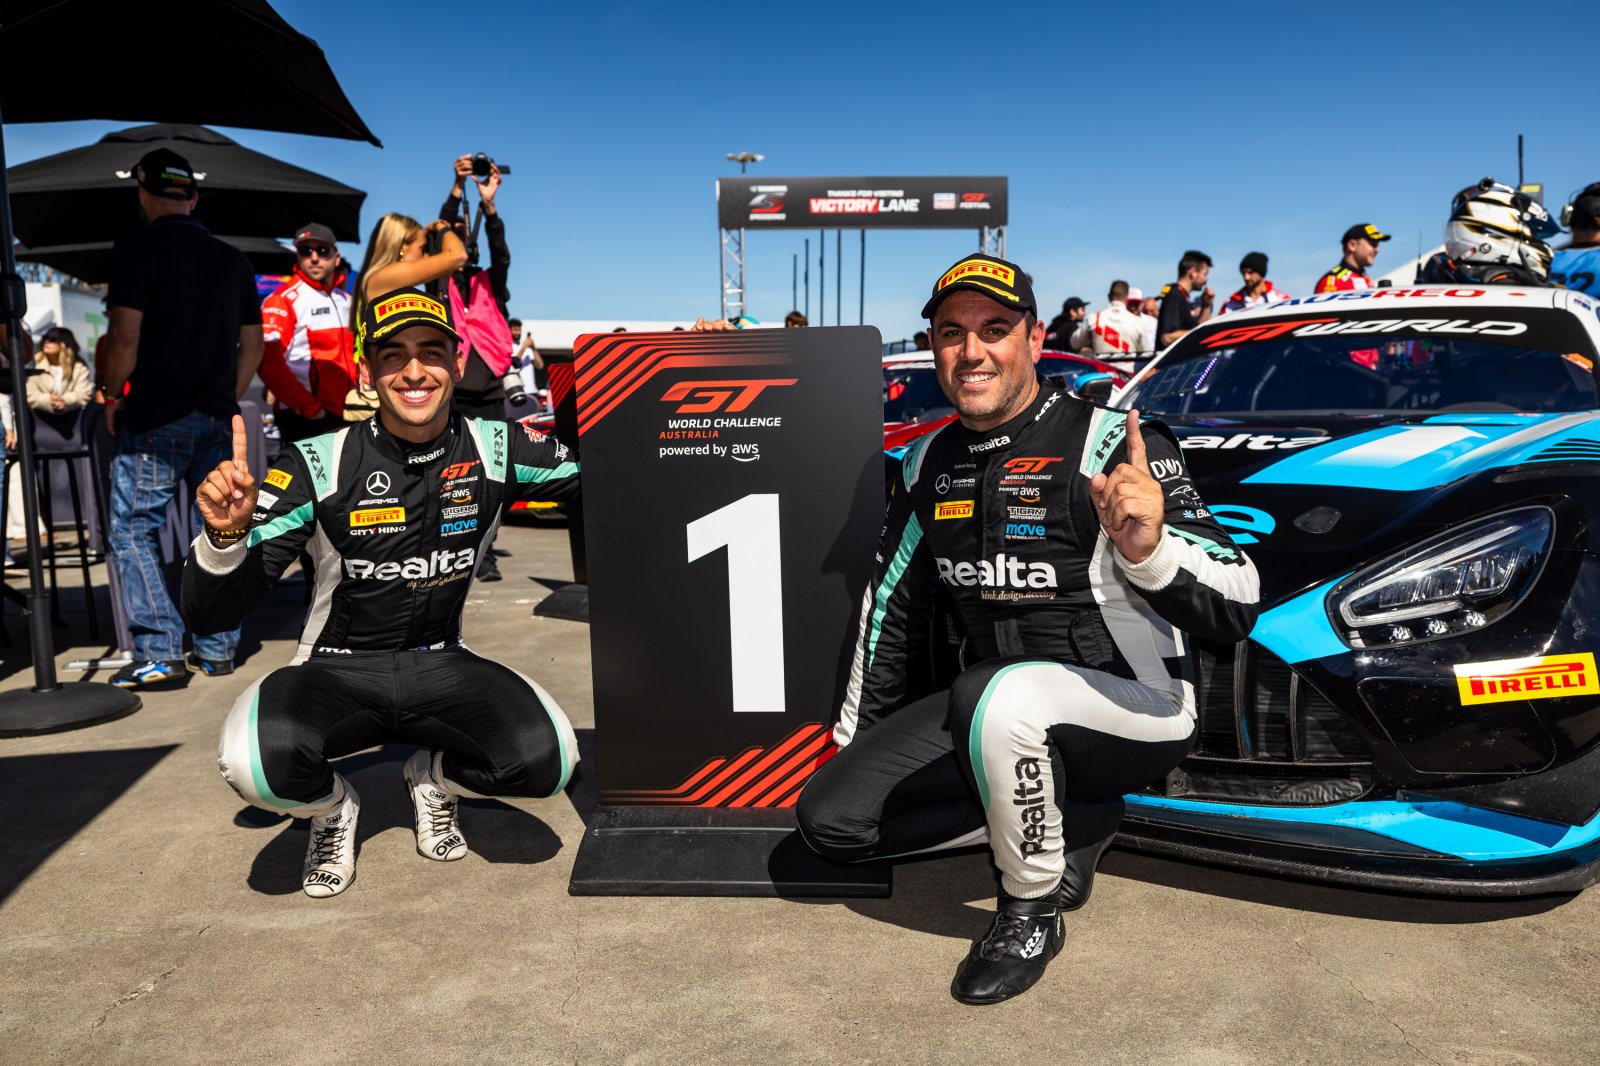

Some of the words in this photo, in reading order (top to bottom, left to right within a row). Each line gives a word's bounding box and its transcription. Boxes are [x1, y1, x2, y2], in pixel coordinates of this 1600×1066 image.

[811, 198, 877, 213] VICTORY
[878, 198, 920, 212] LANE
[941, 262, 1010, 289] PIRELLI
[377, 296, 443, 317] PIRELLI
[659, 378, 799, 414] GT
[668, 419, 711, 429] WORLD
[713, 417, 782, 428] CHALLENGE
[659, 430, 719, 440] AUSTRALIA
[493, 426, 503, 467] HRX
[659, 444, 710, 458] powered
[712, 443, 727, 457] by
[731, 443, 760, 458] aws
[968, 435, 1011, 453] Realta
[408, 447, 445, 464] Realta
[1003, 457, 1064, 473] GT
[451, 488, 471, 499] aws
[1019, 487, 1040, 498] aws
[366, 497, 399, 505] AMG
[355, 509, 400, 523] PIRELLI
[441, 504, 479, 515] TIGANI
[939, 503, 972, 517] PIRELLI
[1007, 506, 1047, 516] TIGANI
[350, 528, 376, 536] CITY
[379, 526, 406, 534] HINO
[441, 518, 478, 533] move
[1006, 523, 1046, 536] move
[344, 547, 475, 581] Realta
[934, 553, 1058, 588] Realta
[686, 493, 785, 712] 1
[1469, 662, 1586, 695] PIRELLI
[429, 789, 447, 800] OMP
[1012, 757, 1047, 861] Realta
[315, 814, 343, 825] OMP
[435, 833, 462, 857] OMP
[307, 871, 342, 887] OMP
